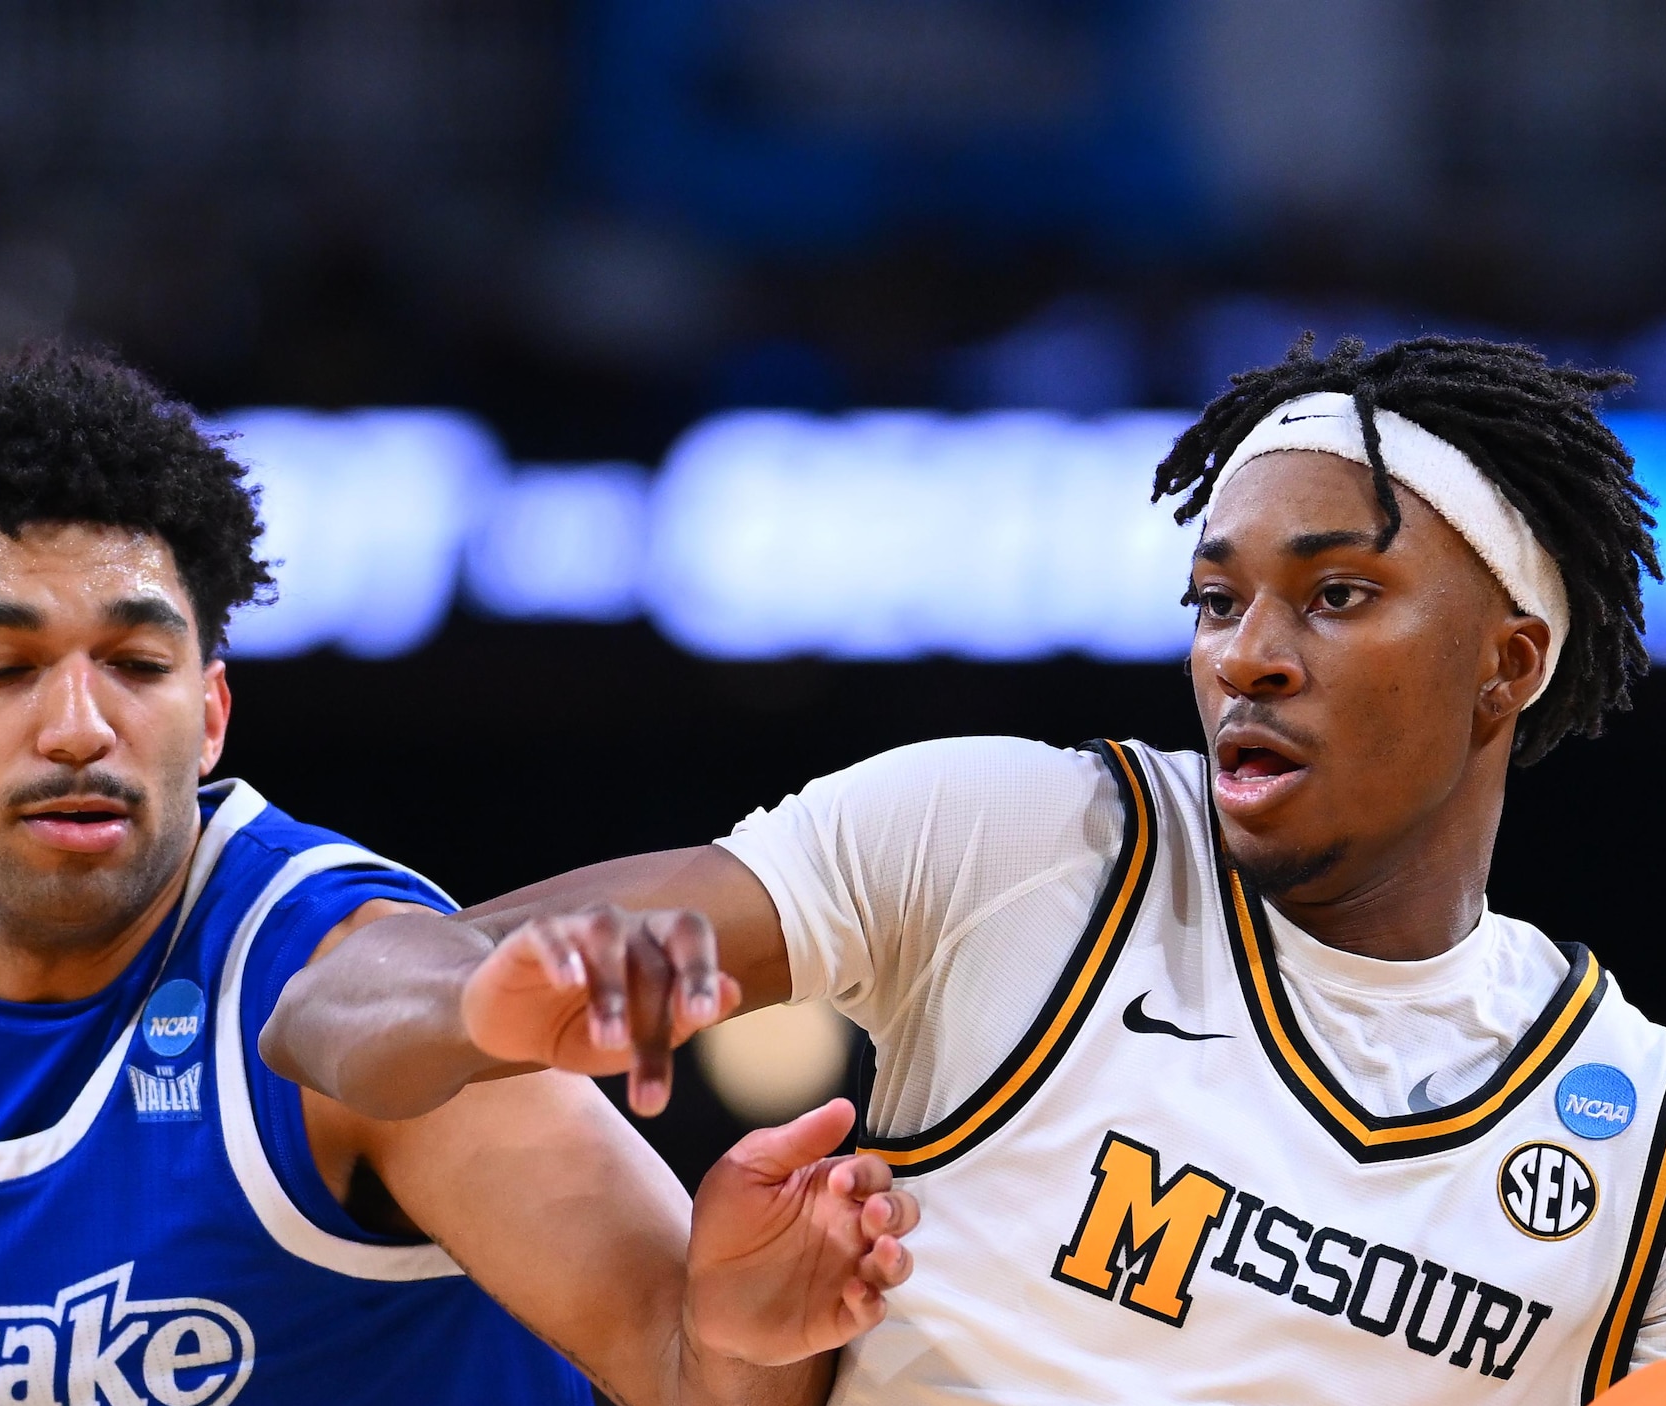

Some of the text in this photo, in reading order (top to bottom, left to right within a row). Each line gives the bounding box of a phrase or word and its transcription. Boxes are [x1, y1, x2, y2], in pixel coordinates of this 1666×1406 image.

[149, 1015, 199, 1038] NCAA
[127, 1062, 204, 1113] VALLEY
[1564, 1093, 1630, 1125] NCAA
[1506, 1146, 1592, 1234] SEC
[1051, 1130, 1554, 1381] MISSOURI
